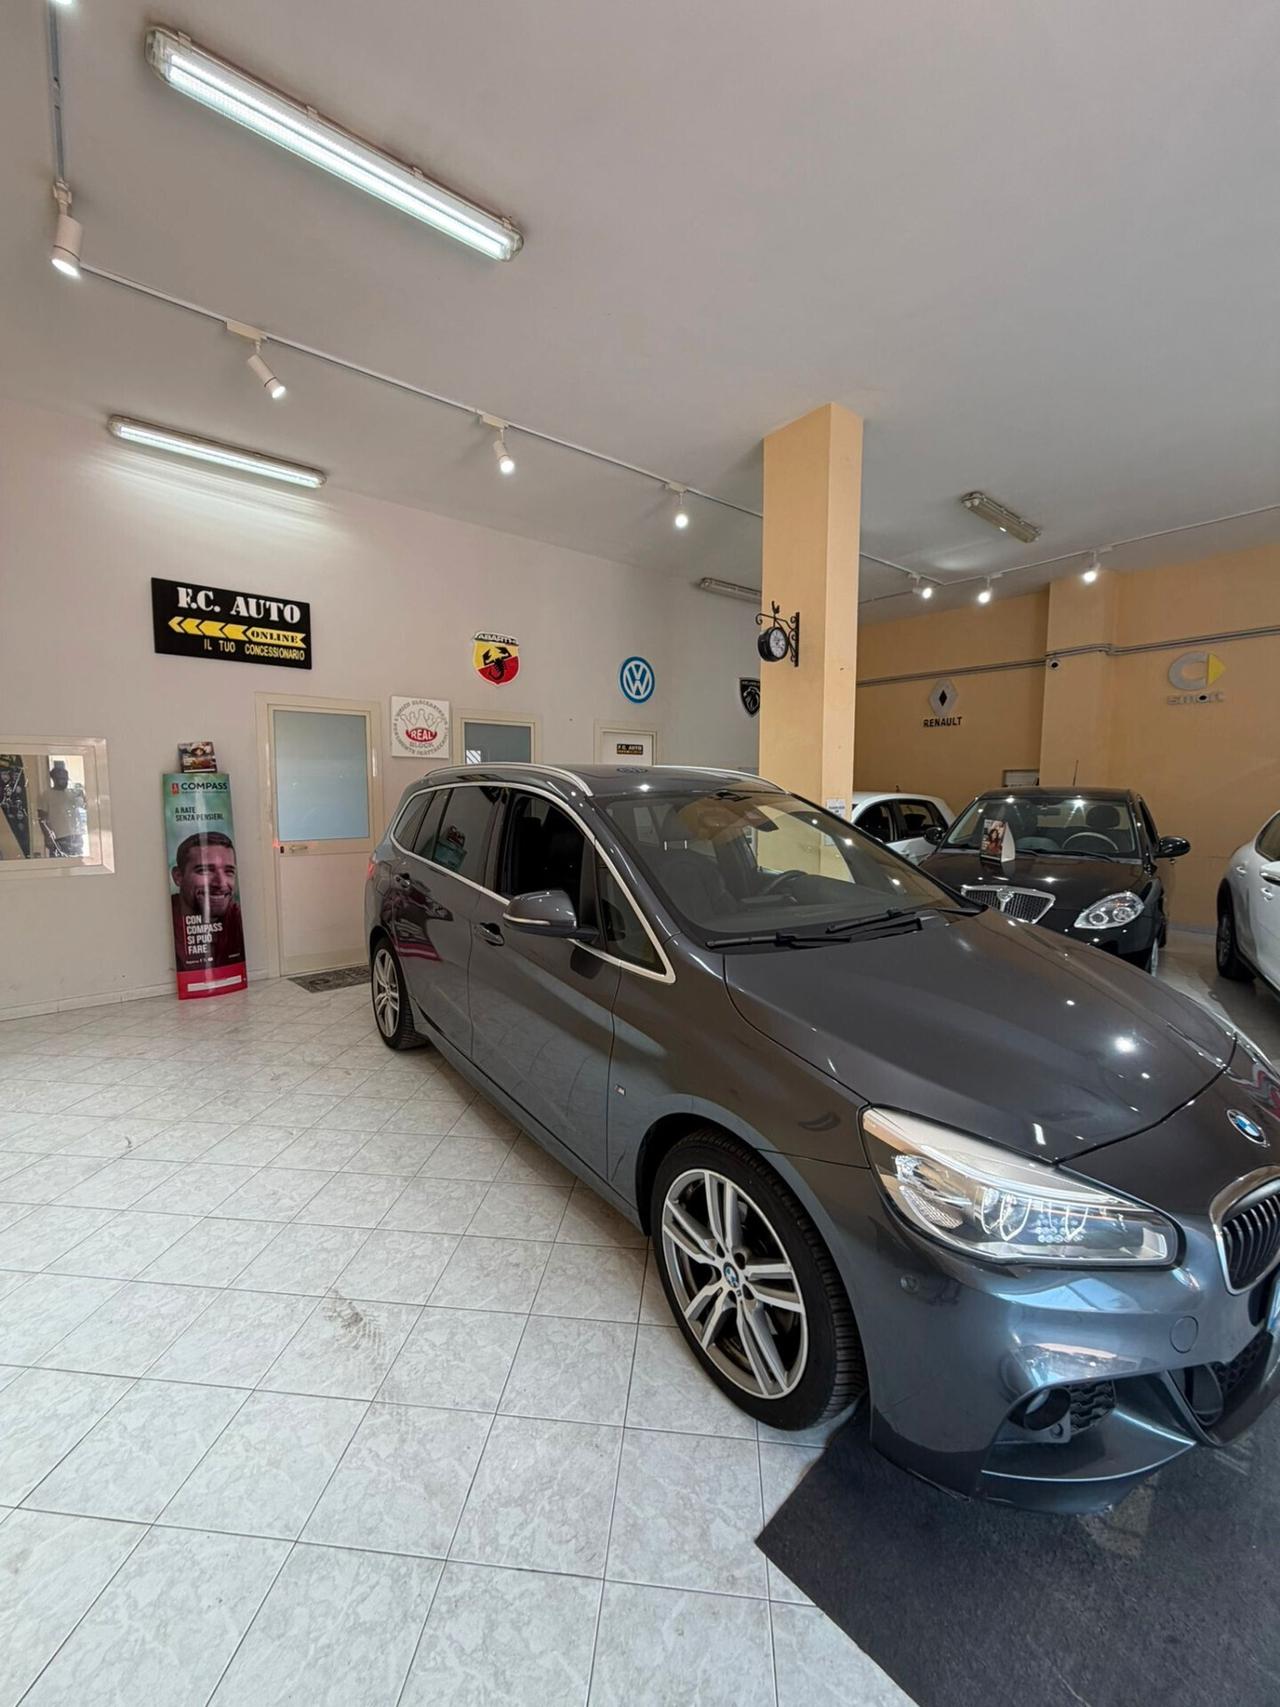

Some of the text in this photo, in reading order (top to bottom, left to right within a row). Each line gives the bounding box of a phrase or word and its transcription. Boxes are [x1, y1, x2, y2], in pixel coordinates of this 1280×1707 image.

[176, 586, 301, 624] F.C. AUTO
[252, 630, 299, 644] ONLINE
[203, 638, 305, 661] IL TUO CONCESSIONARIO
[1168, 692, 1224, 705] smrt
[923, 716, 962, 728] RENAULT
[410, 729, 433, 741] REAL
[180, 782, 228, 791] COMPASS
[180, 806, 196, 814] RATE
[175, 813, 195, 822] SENZA
[185, 914, 202, 925] CON
[186, 922, 223, 935] COMPASS
[187, 935, 195, 945] SI
[188, 944, 208, 955] FARE
